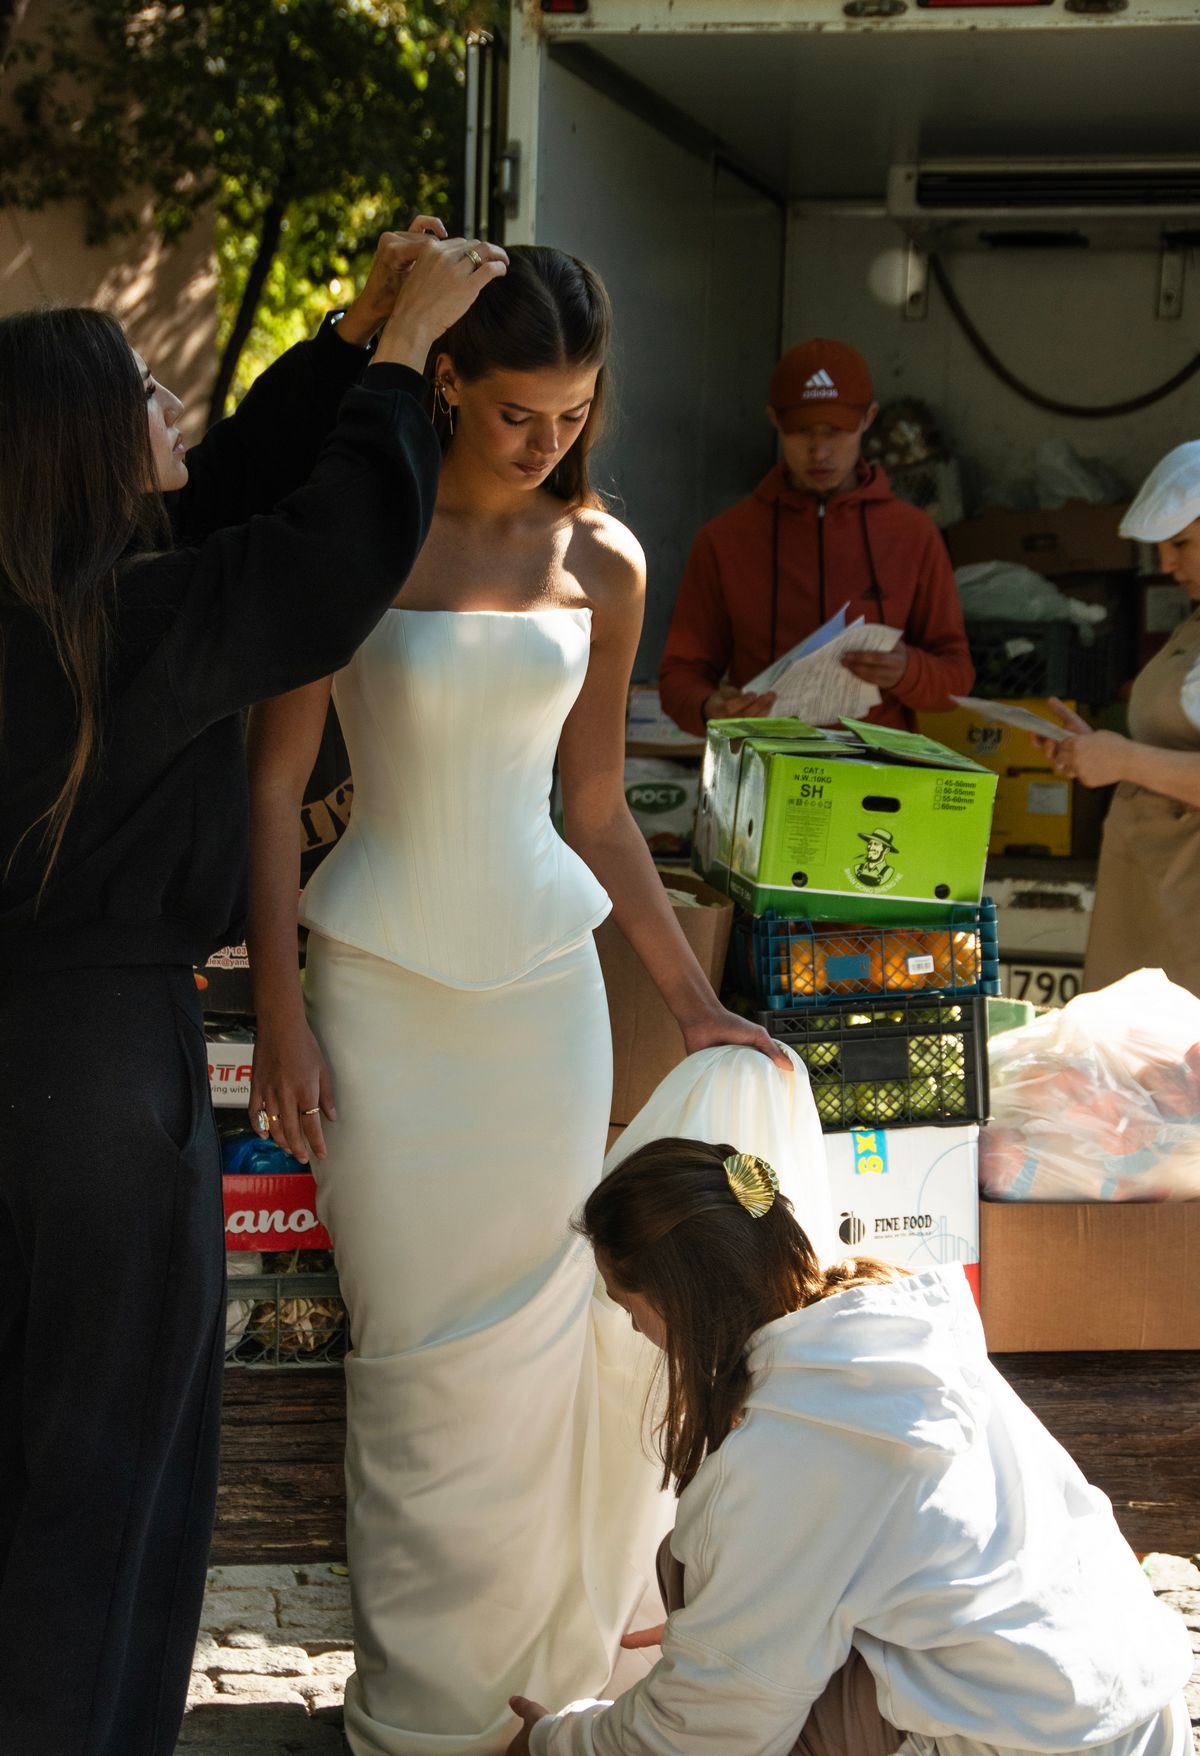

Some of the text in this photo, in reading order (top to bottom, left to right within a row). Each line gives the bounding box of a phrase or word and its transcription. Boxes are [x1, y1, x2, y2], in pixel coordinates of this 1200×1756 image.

[802, 388, 839, 399] adidas
[800, 783, 824, 799] SH
[1013, 970, 1079, 1004] 790
[224, 1208, 319, 1234] ano
[874, 1214, 932, 1232] FINE FOOD
